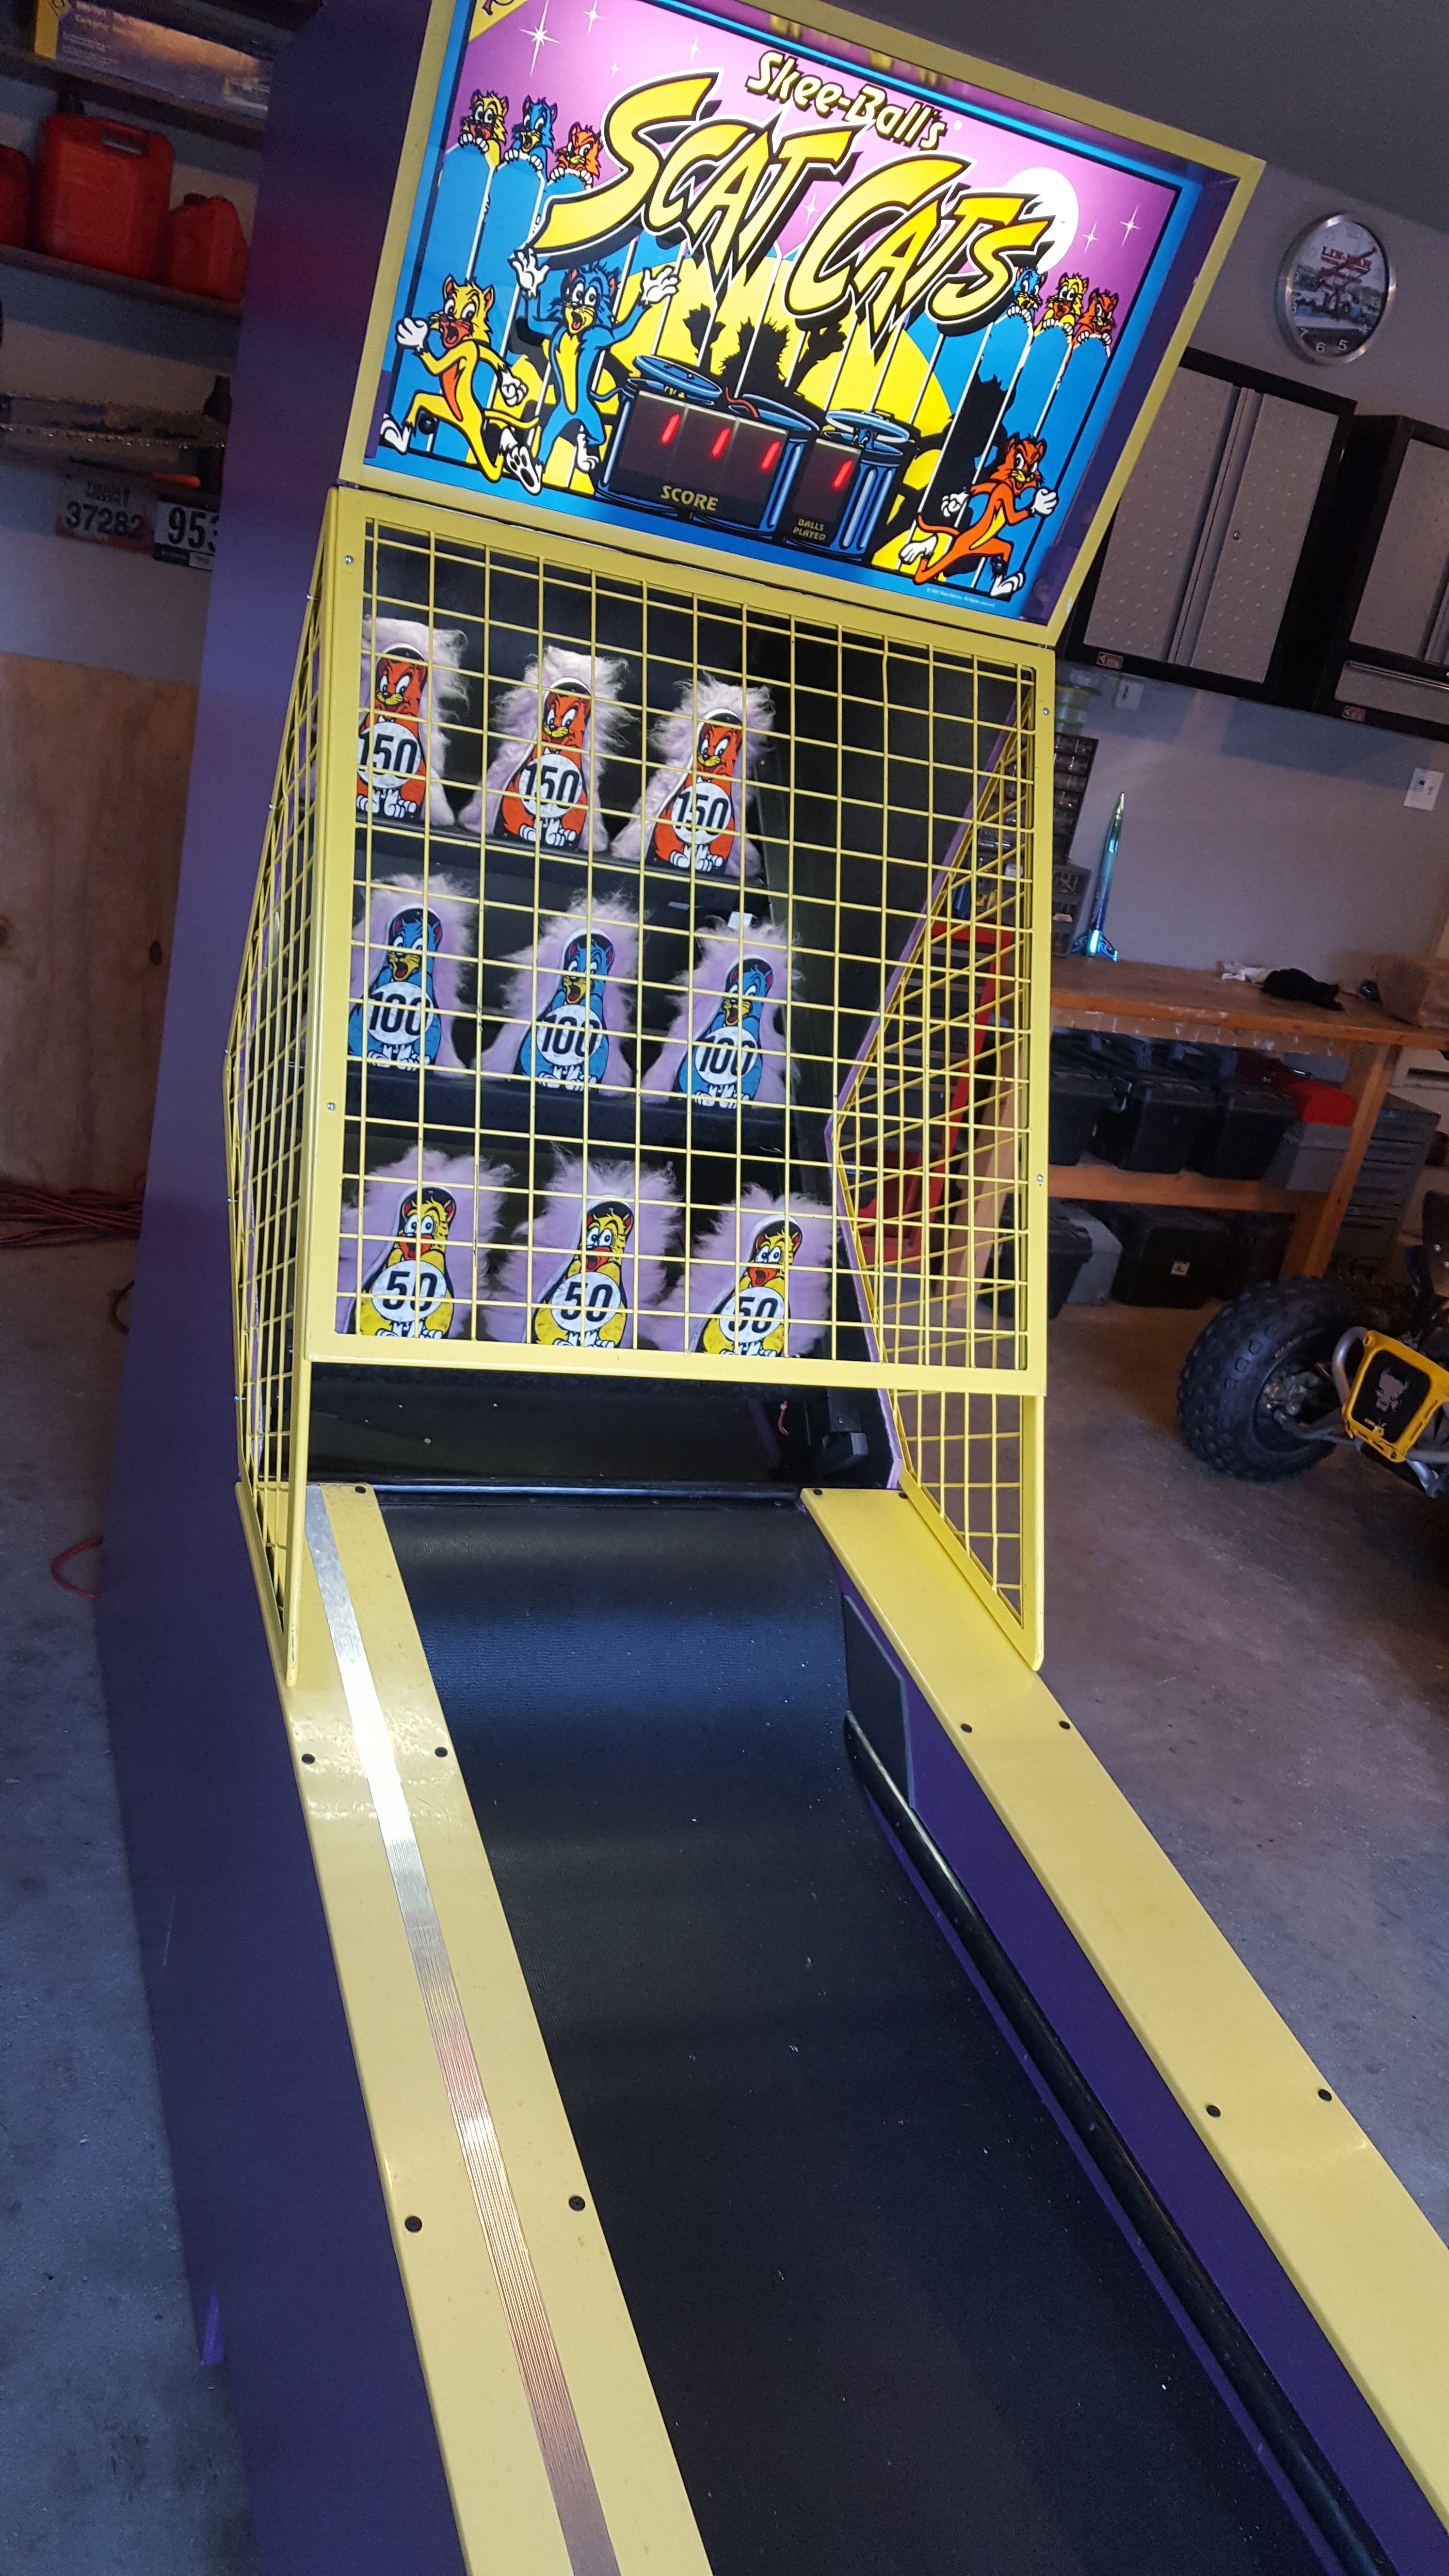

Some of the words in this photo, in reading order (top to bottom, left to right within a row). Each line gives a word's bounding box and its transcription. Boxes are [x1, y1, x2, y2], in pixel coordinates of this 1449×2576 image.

[745, 50, 947, 150] Skee-Ball's
[531, 70, 859, 291] SCAT
[785, 155, 1056, 352] CATS
[1316, 342, 1325, 352] 6
[1338, 339, 1348, 350] 5
[660, 485, 719, 512] SCORE
[793, 527, 826, 541] PLAYED
[798, 518, 824, 531] BALLS
[358, 731, 418, 774] 150
[524, 765, 583, 806] 150
[675, 791, 730, 830] 150
[367, 994, 429, 1034] 100
[541, 1016, 601, 1057] 100
[698, 1038, 757, 1076] 100
[386, 1270, 438, 1312] 50
[560, 1281, 613, 1322] 50
[728, 1296, 777, 1335] 50
